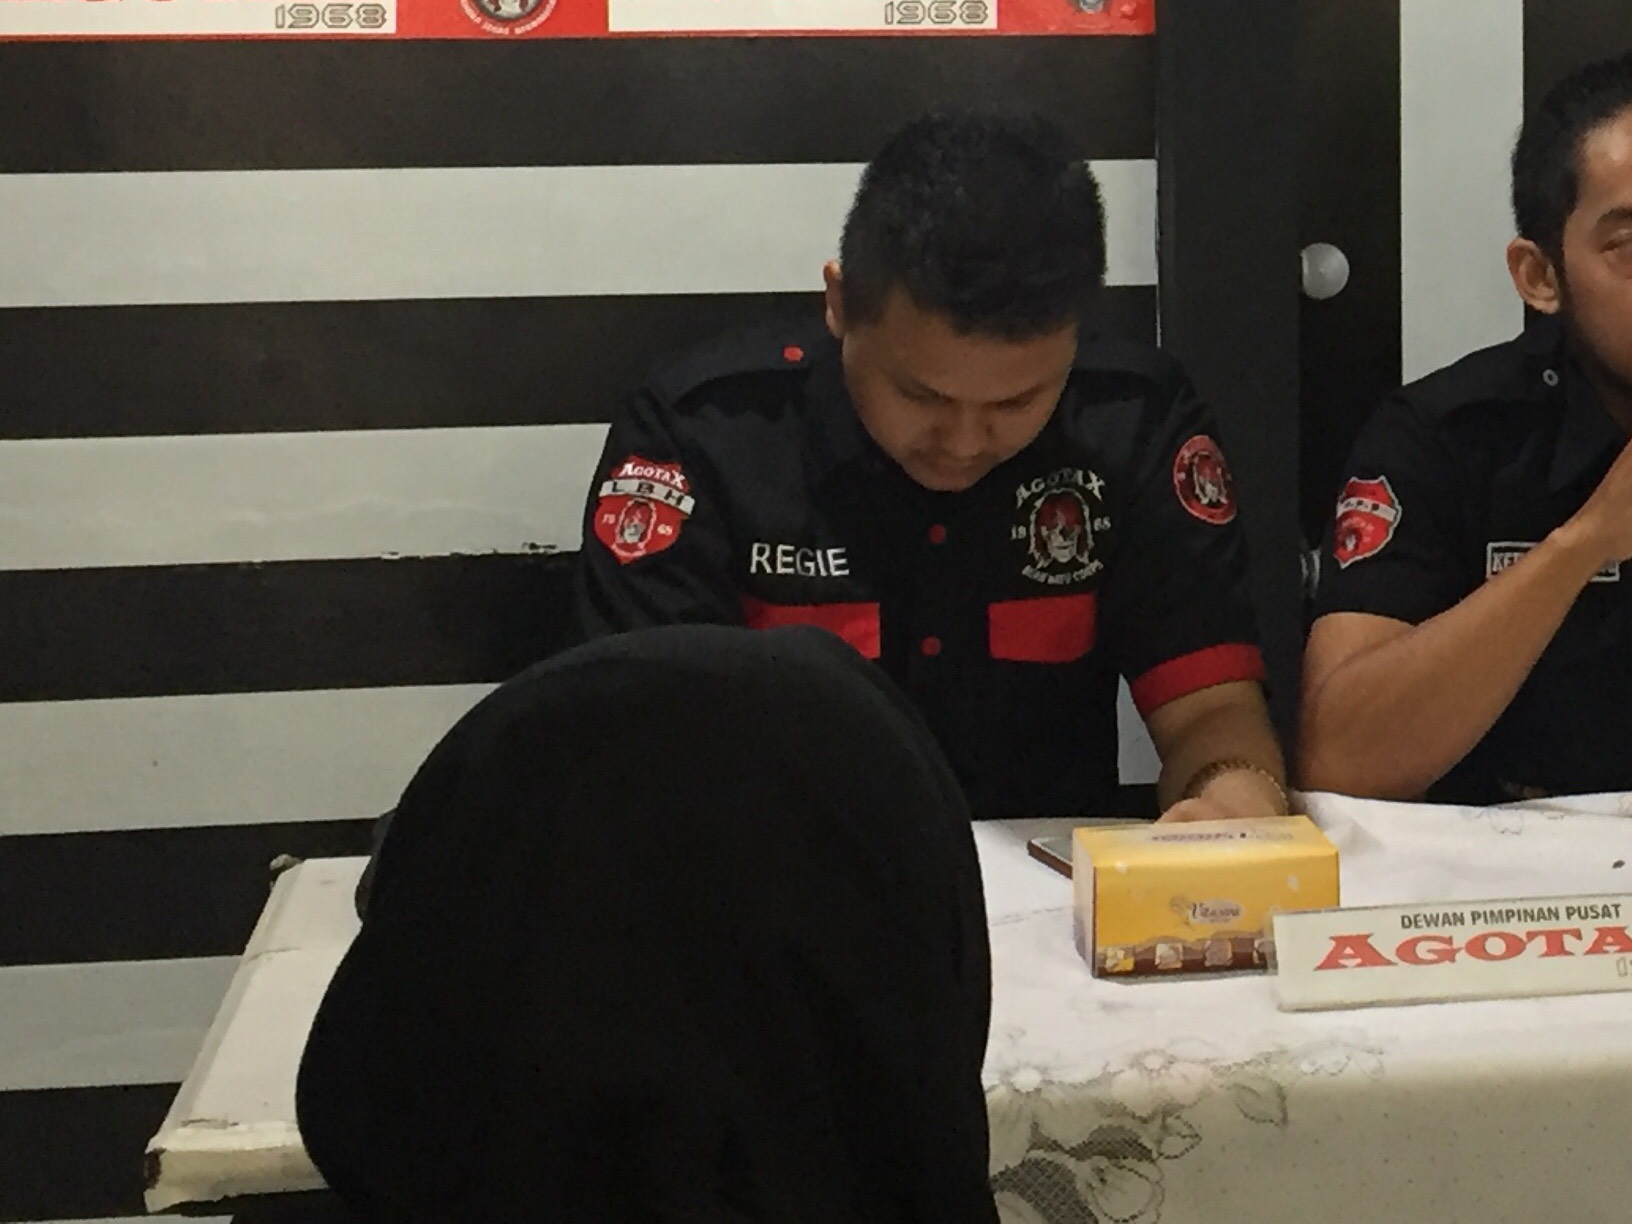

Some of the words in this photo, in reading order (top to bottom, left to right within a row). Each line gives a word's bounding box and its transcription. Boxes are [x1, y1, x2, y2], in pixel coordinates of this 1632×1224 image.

[273, 3, 388, 30] 1968
[884, 0, 990, 26] 1968
[749, 542, 850, 577] REGIE
[1400, 912, 1465, 930] DEWAN
[1470, 907, 1560, 927] PIMPINAN
[1565, 903, 1622, 922] PUSAT
